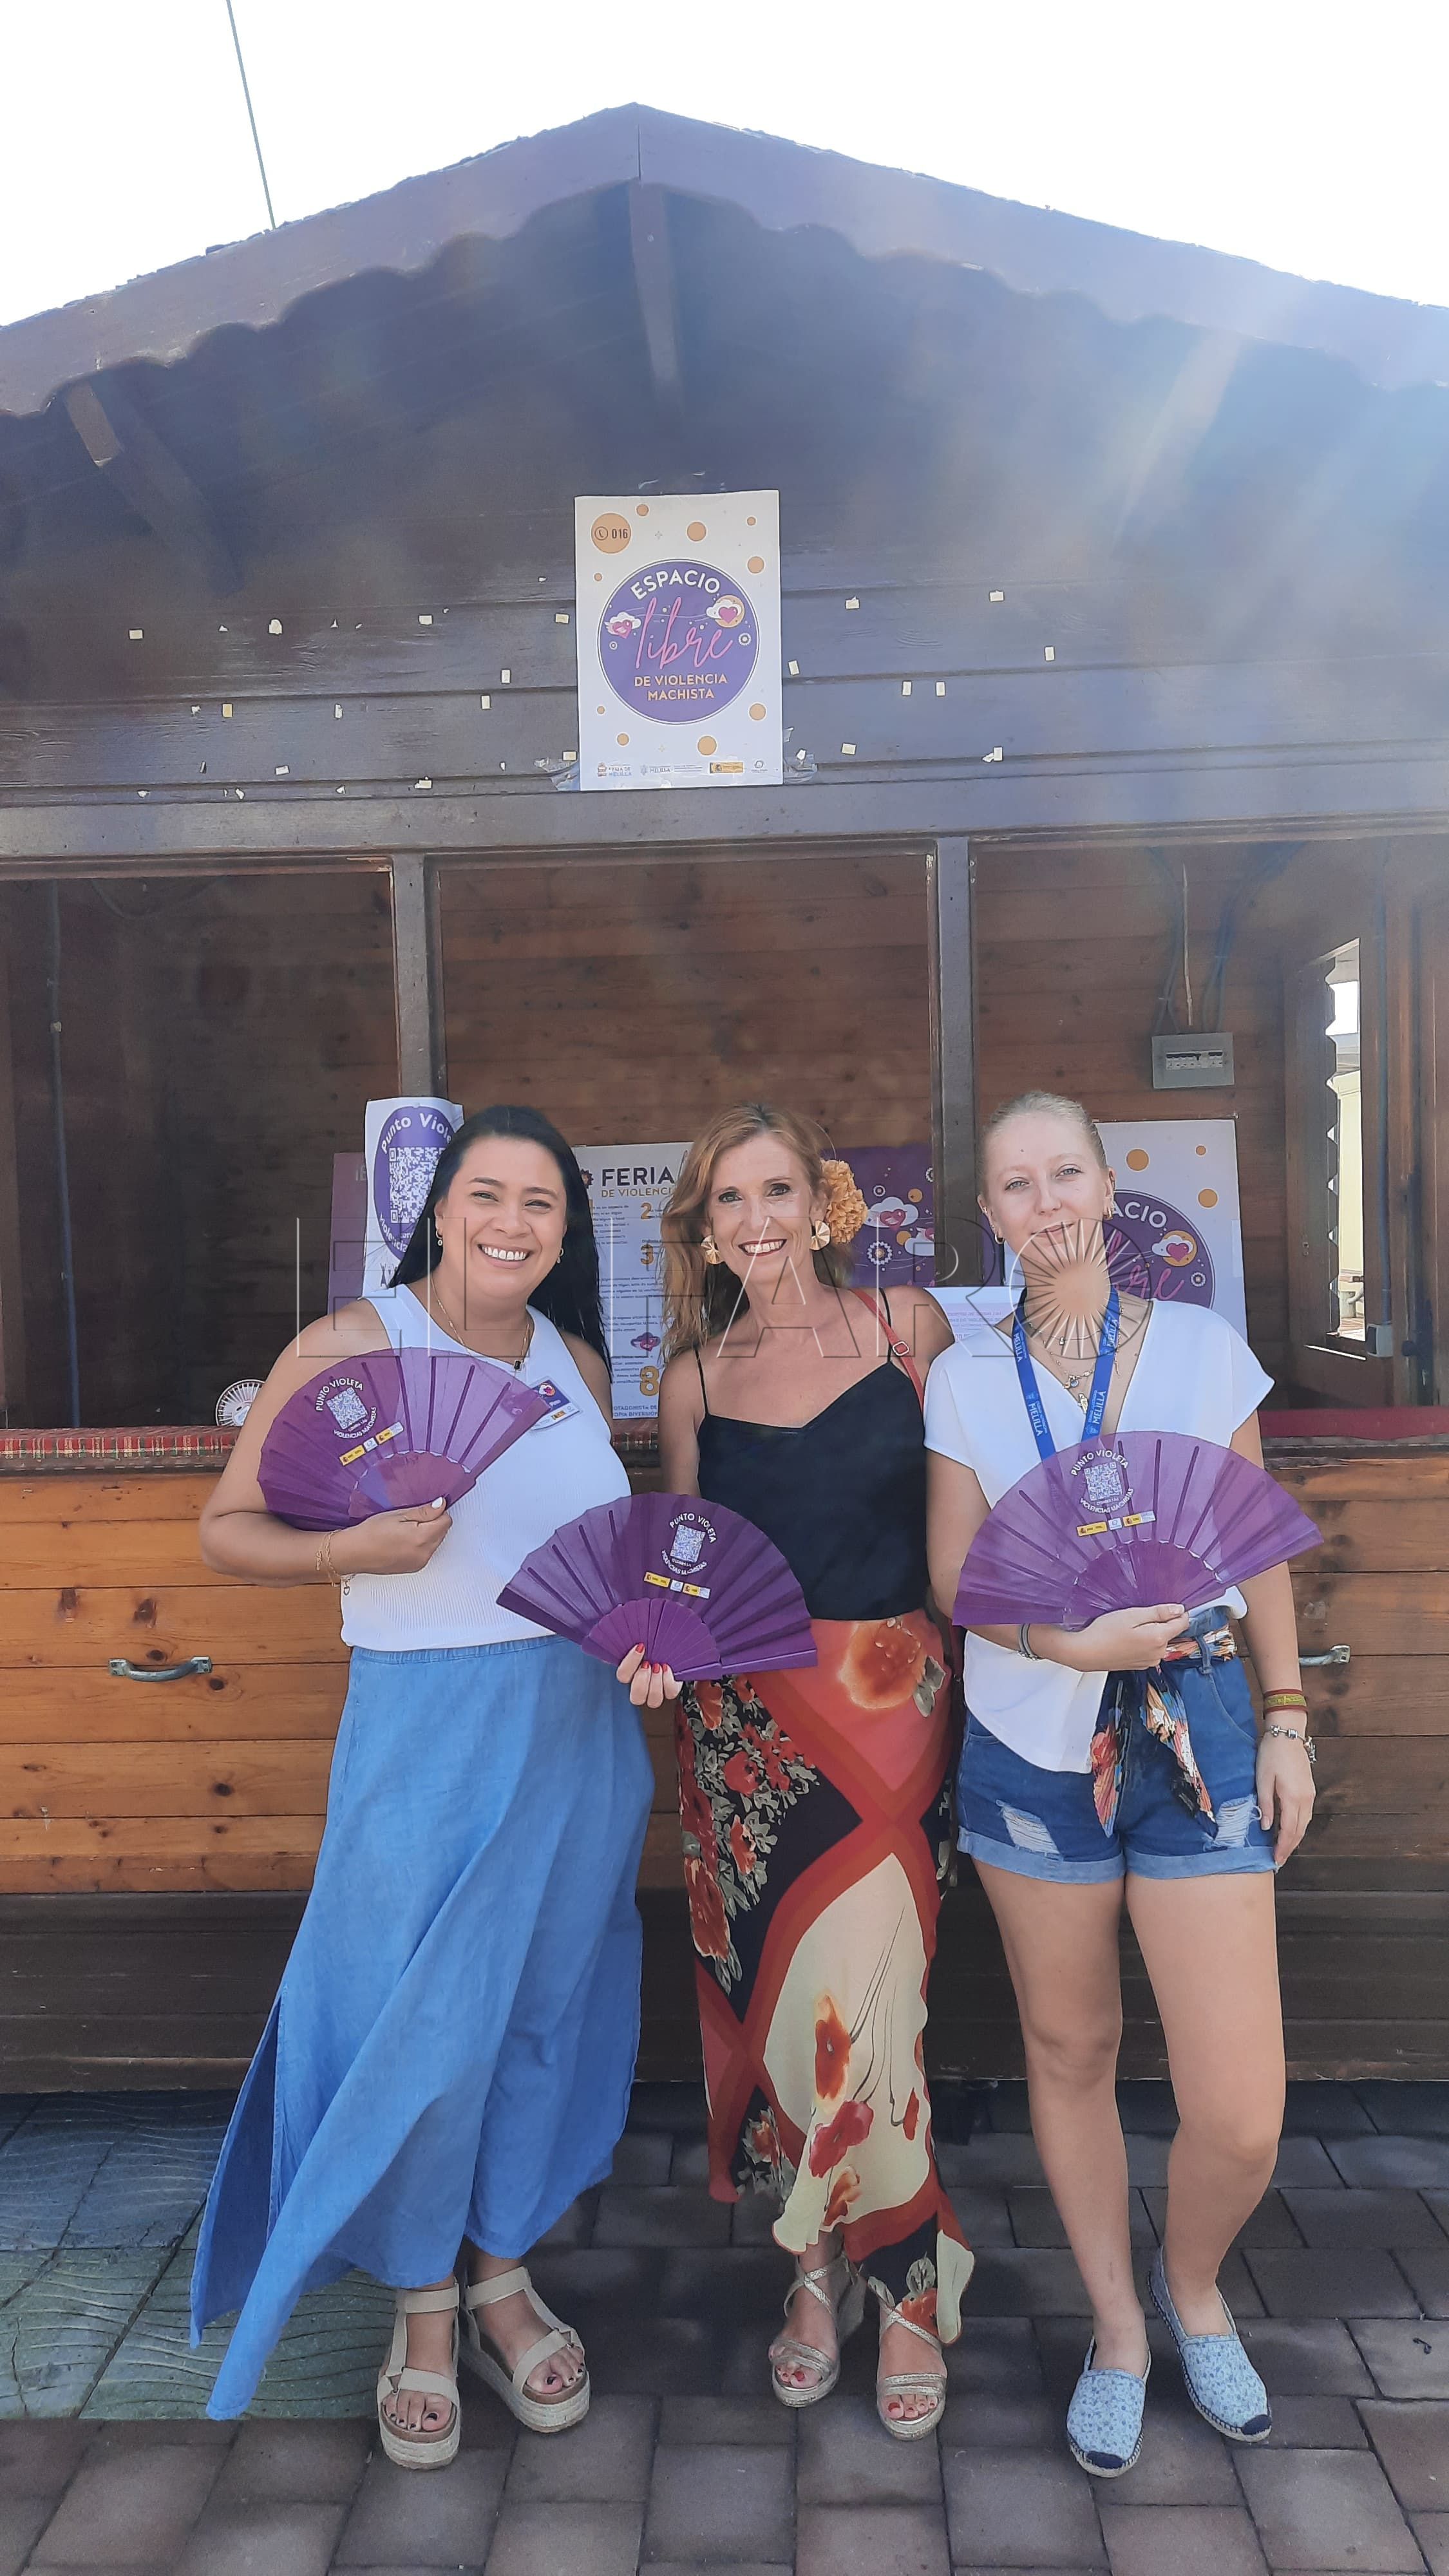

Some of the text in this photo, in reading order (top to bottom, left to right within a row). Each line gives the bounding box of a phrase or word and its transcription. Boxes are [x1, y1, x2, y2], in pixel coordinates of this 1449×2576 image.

[612, 528, 628, 539] 016
[630, 569, 720, 600] ESPACIO
[636, 597, 733, 669] libre
[634, 674, 727, 687] DE VIOLENCIA
[648, 688, 714, 701] MACHISTA
[381, 1113, 451, 1155] Punto Viole
[602, 1166, 675, 1187] FERIA
[601, 1188, 672, 1198] DE VIOLENCI
[641, 1202, 652, 1219] 2
[1112, 1200, 1166, 1228] ACIO
[641, 1244, 654, 1264] 3
[316, 1378, 363, 1411] PUNTO VIOLETA
[639, 1365, 659, 1396] 8
[1028, 1403, 1043, 1436] MELILLA
[1092, 1390, 1106, 1425] MELILLA
[1070, 1450, 1128, 1475] PUNTO VIOLETA
[669, 1513, 717, 1543] PUNTO VIOLETA
